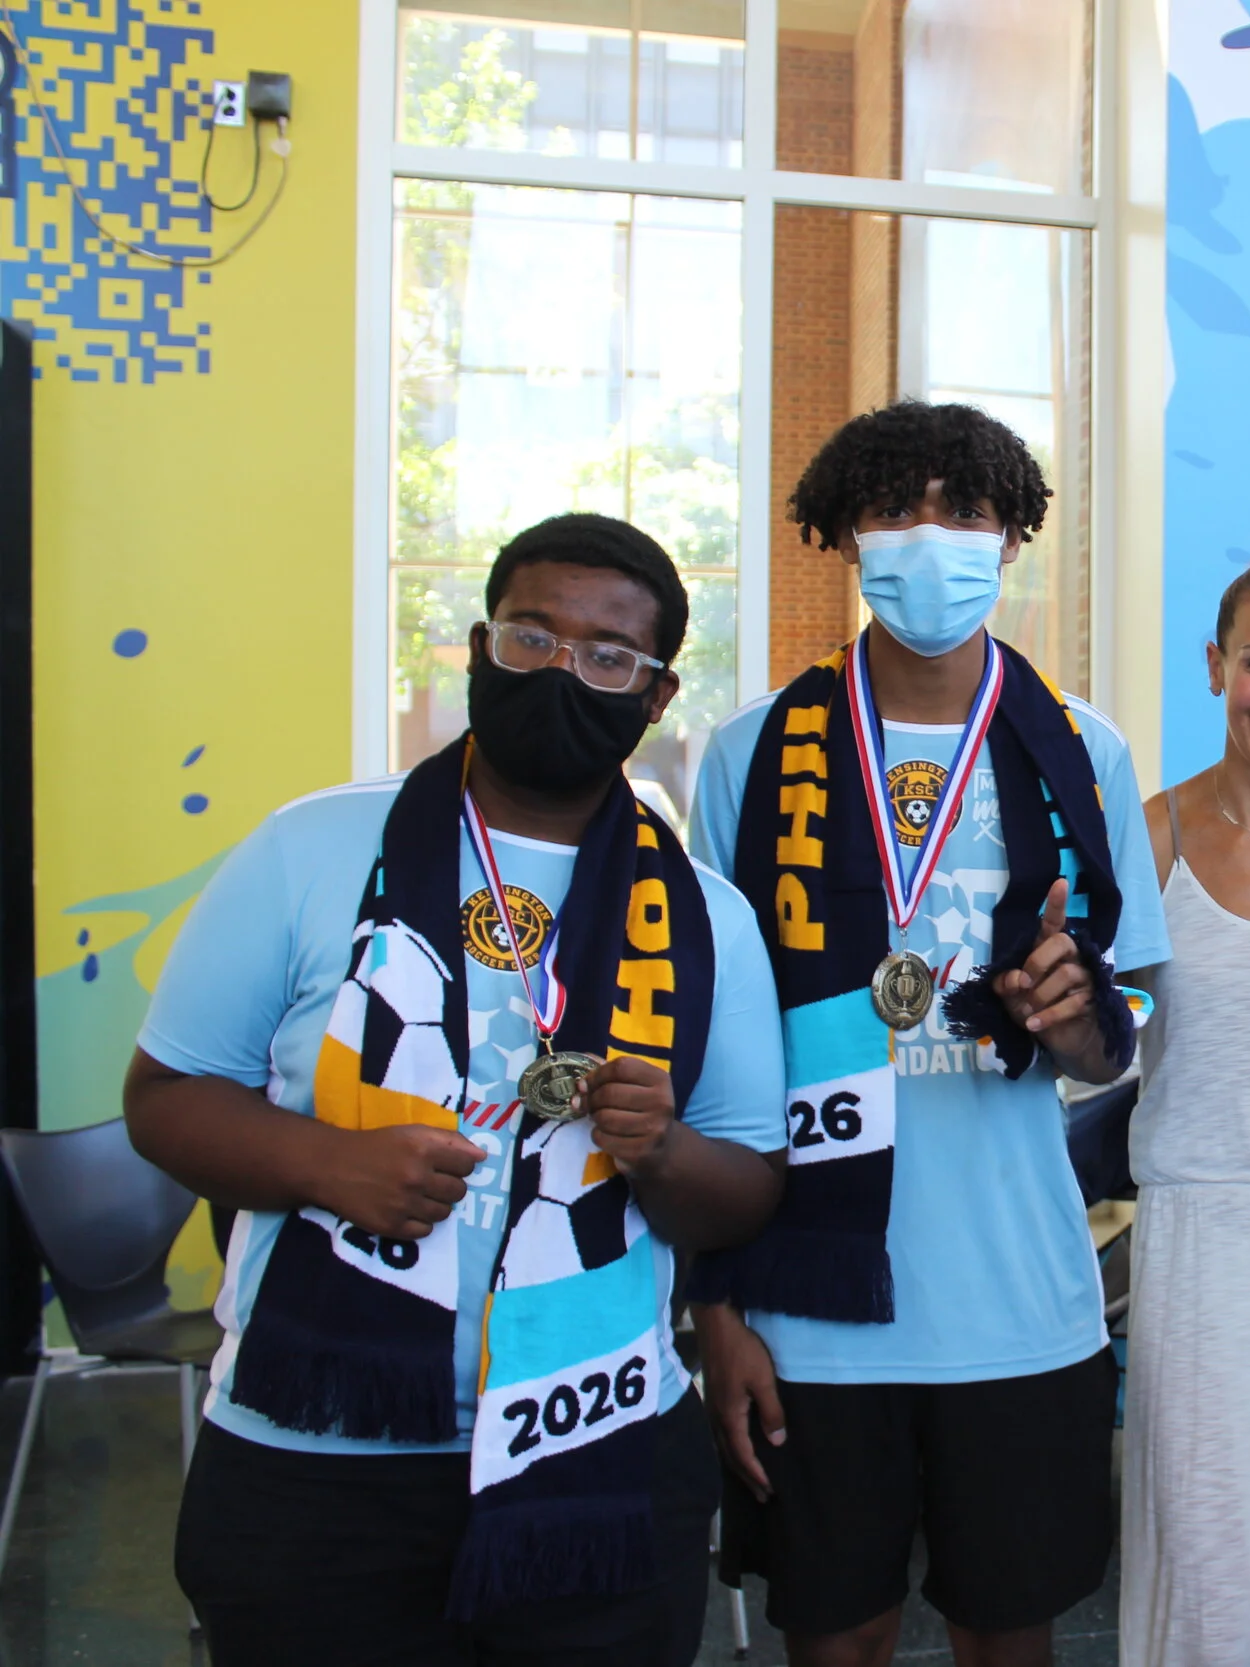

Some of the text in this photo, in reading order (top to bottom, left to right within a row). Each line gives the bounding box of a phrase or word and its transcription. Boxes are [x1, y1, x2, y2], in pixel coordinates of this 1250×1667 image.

[886, 762, 948, 781] ENSINGT
[904, 785, 933, 795] KSC
[468, 886, 550, 921] KEINGTON
[463, 940, 504, 969] SOCCER
[788, 1091, 862, 1149] 26
[503, 1355, 646, 1458] 2026
